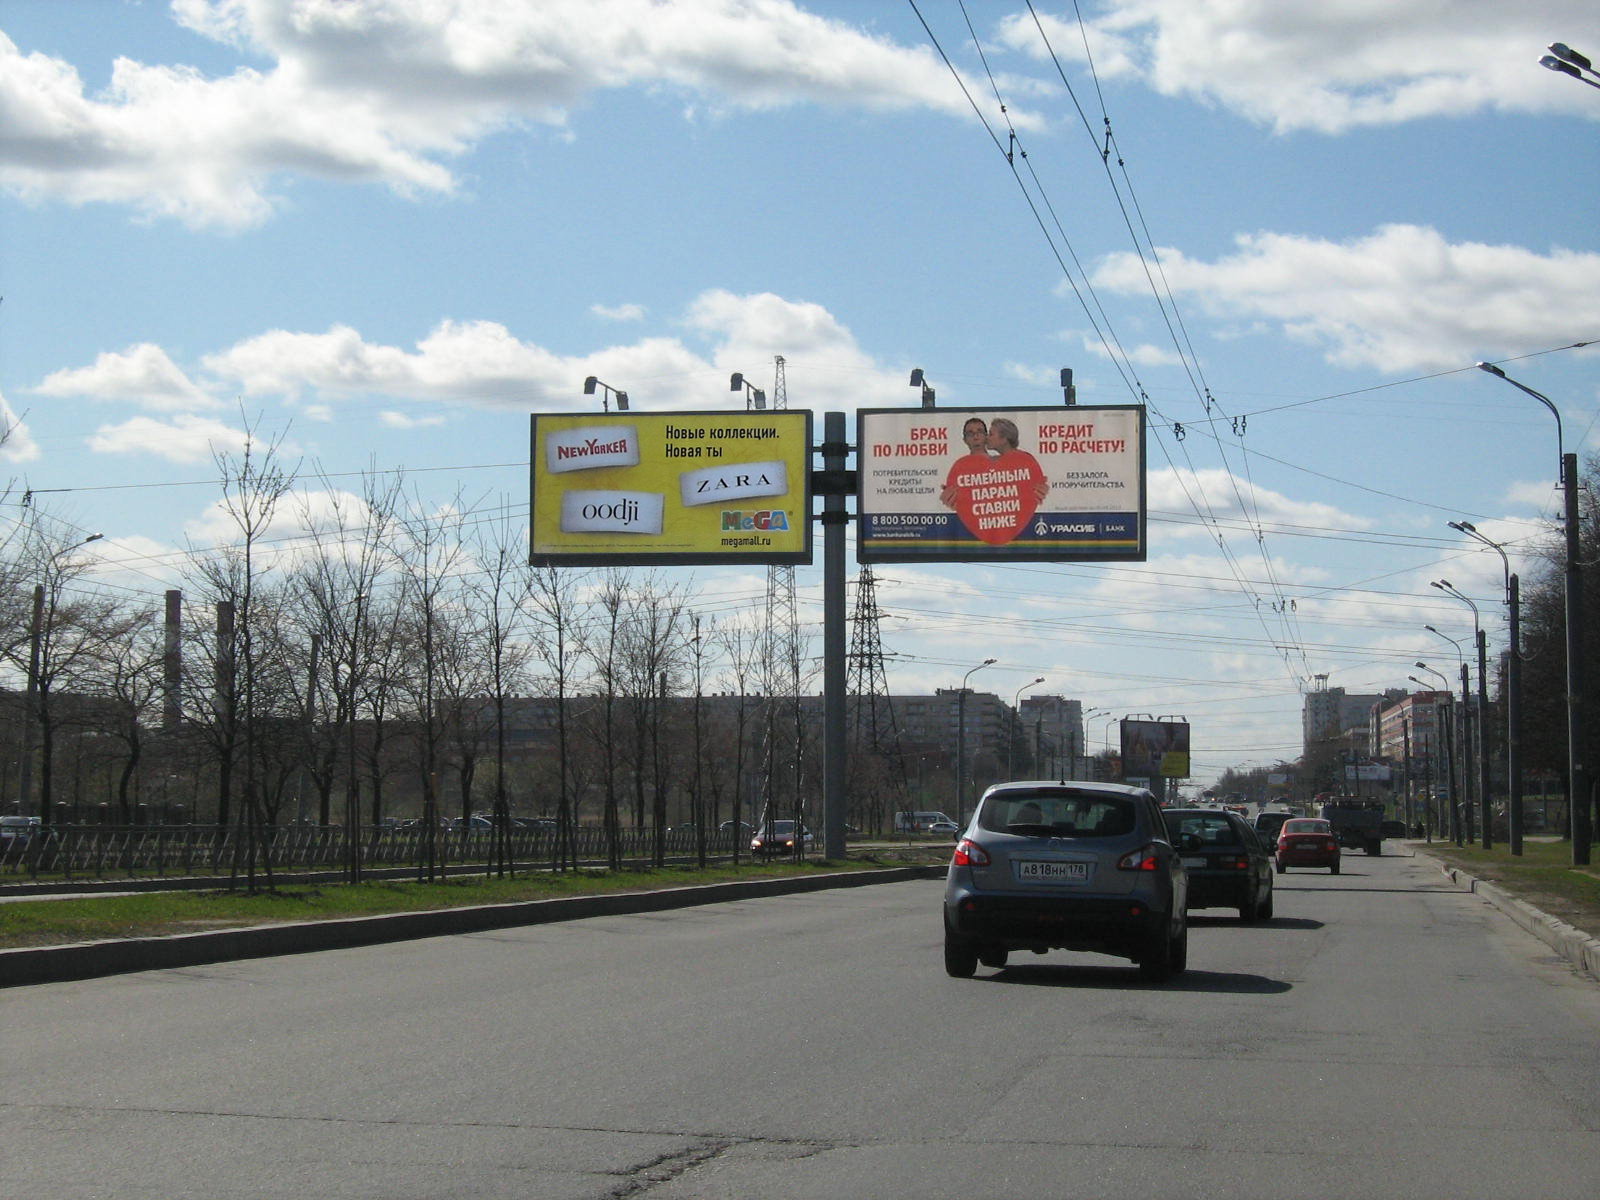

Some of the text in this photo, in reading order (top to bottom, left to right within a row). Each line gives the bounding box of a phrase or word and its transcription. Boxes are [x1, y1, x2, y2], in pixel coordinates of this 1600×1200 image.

[665, 425, 780, 441] Новые коллекции.
[910, 427, 948, 440] БРАК
[1039, 424, 1094, 440] КРЕДИТ
[665, 443, 723, 458] Новая ты
[873, 443, 948, 457] ПО ЛЮБВИ
[1039, 440, 1125, 454] ПО РАСЧЕТУ!
[873, 468, 938, 477] ПОТРЕБИТЕЛЬСКИЕ
[956, 468, 1031, 487] СЕМЕЙНЫМ
[1080, 471, 1109, 479] ЗАЛОГА
[696, 473, 772, 494] ZARA
[888, 478, 922, 486] КРЕДИТЫ
[1058, 481, 1125, 489] ПОРУЧИТЕЛЬСТВА
[915, 487, 935, 495] ЦЕЛИ
[971, 485, 1018, 500] ПАРАМ
[582, 498, 639, 526] oodji
[971, 499, 1021, 515] СТАВКИ
[872, 515, 948, 525] 8 800 500 00 00
[978, 516, 1017, 530] НИЖЕ
[1050, 524, 1095, 533] УРАЛСИБ
[721, 536, 772, 548] megamall.ru
